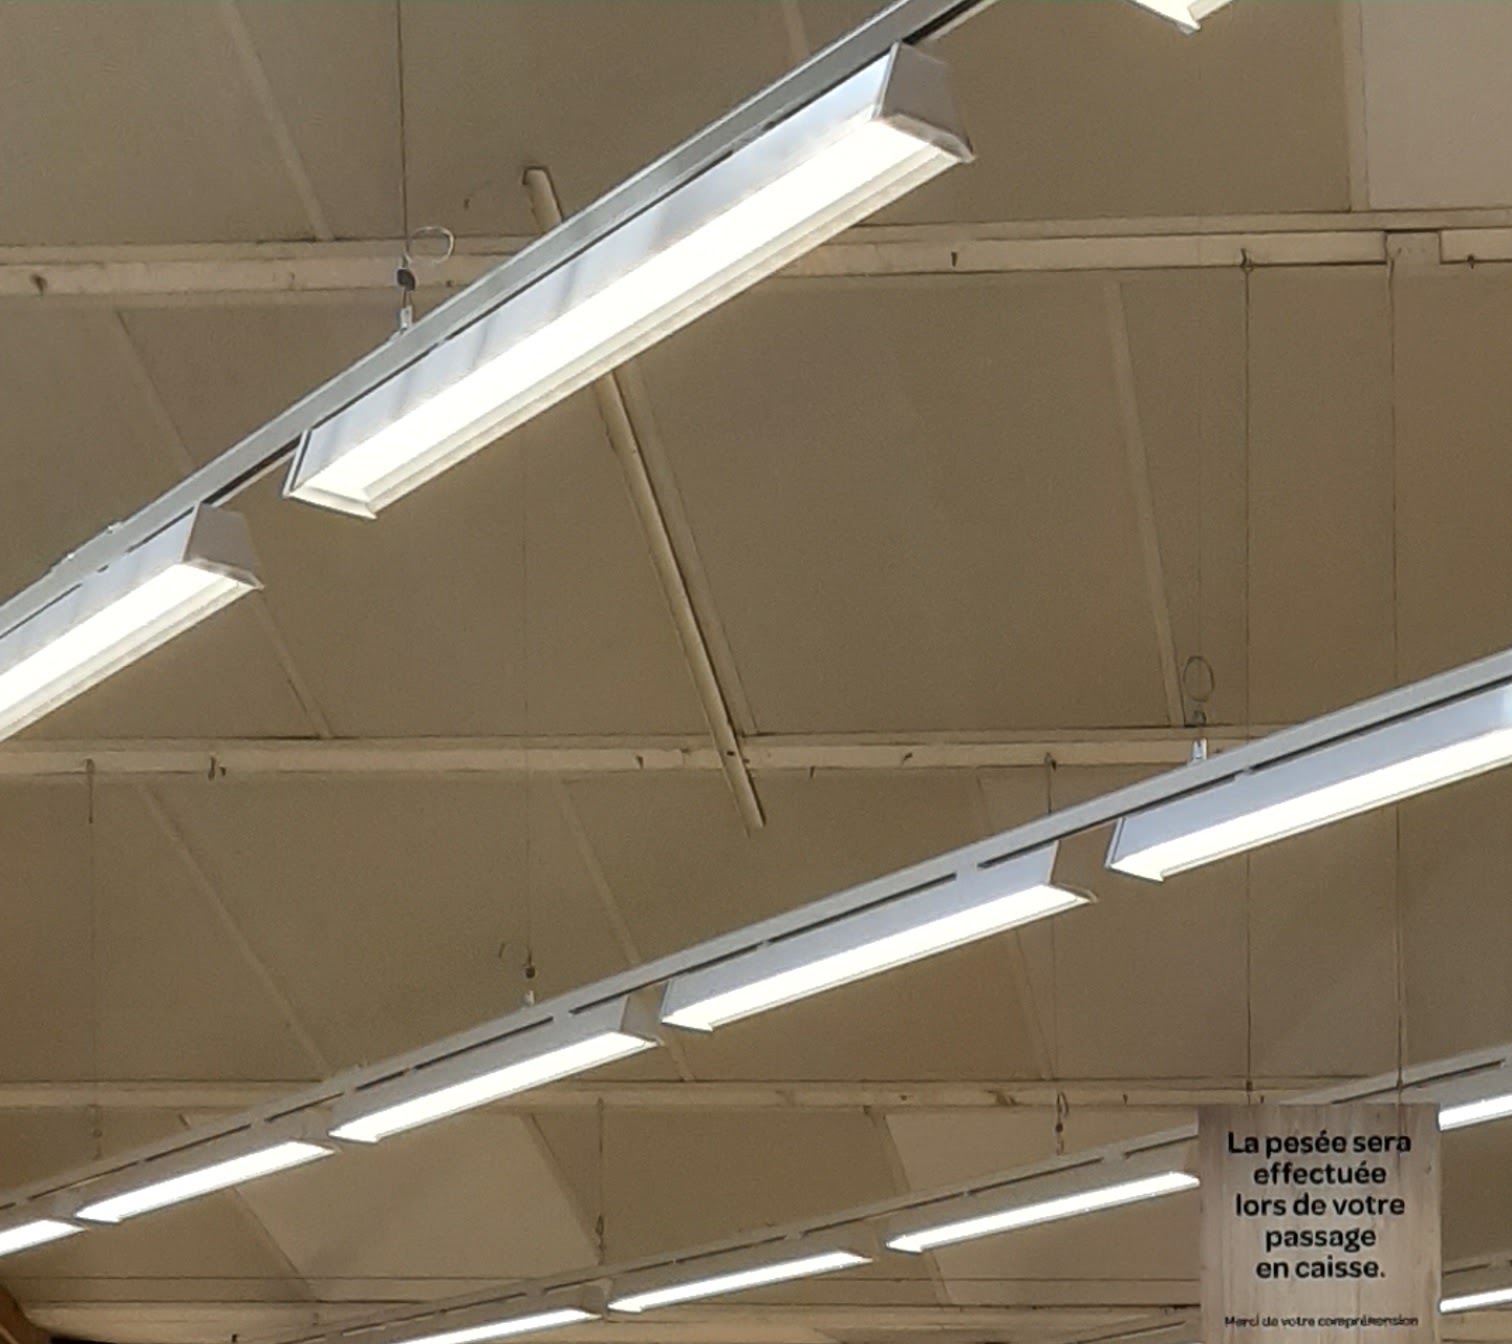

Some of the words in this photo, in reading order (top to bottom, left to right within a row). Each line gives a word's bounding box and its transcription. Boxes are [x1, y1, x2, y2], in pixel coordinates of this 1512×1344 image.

[1228, 1132, 1258, 1153] La
[1266, 1131, 1347, 1158] pesée
[1353, 1134, 1411, 1153] sera
[1254, 1161, 1387, 1184] effectuée
[1236, 1193, 1286, 1216] lors
[1293, 1193, 1326, 1215] de
[1333, 1196, 1405, 1216] votre
[1266, 1227, 1376, 1252] passage
[1256, 1260, 1288, 1278] en
[1295, 1255, 1385, 1278] caisse.
[1225, 1314, 1259, 1327] Merci
[1262, 1315, 1278, 1327] de
[1281, 1316, 1315, 1327] votre
